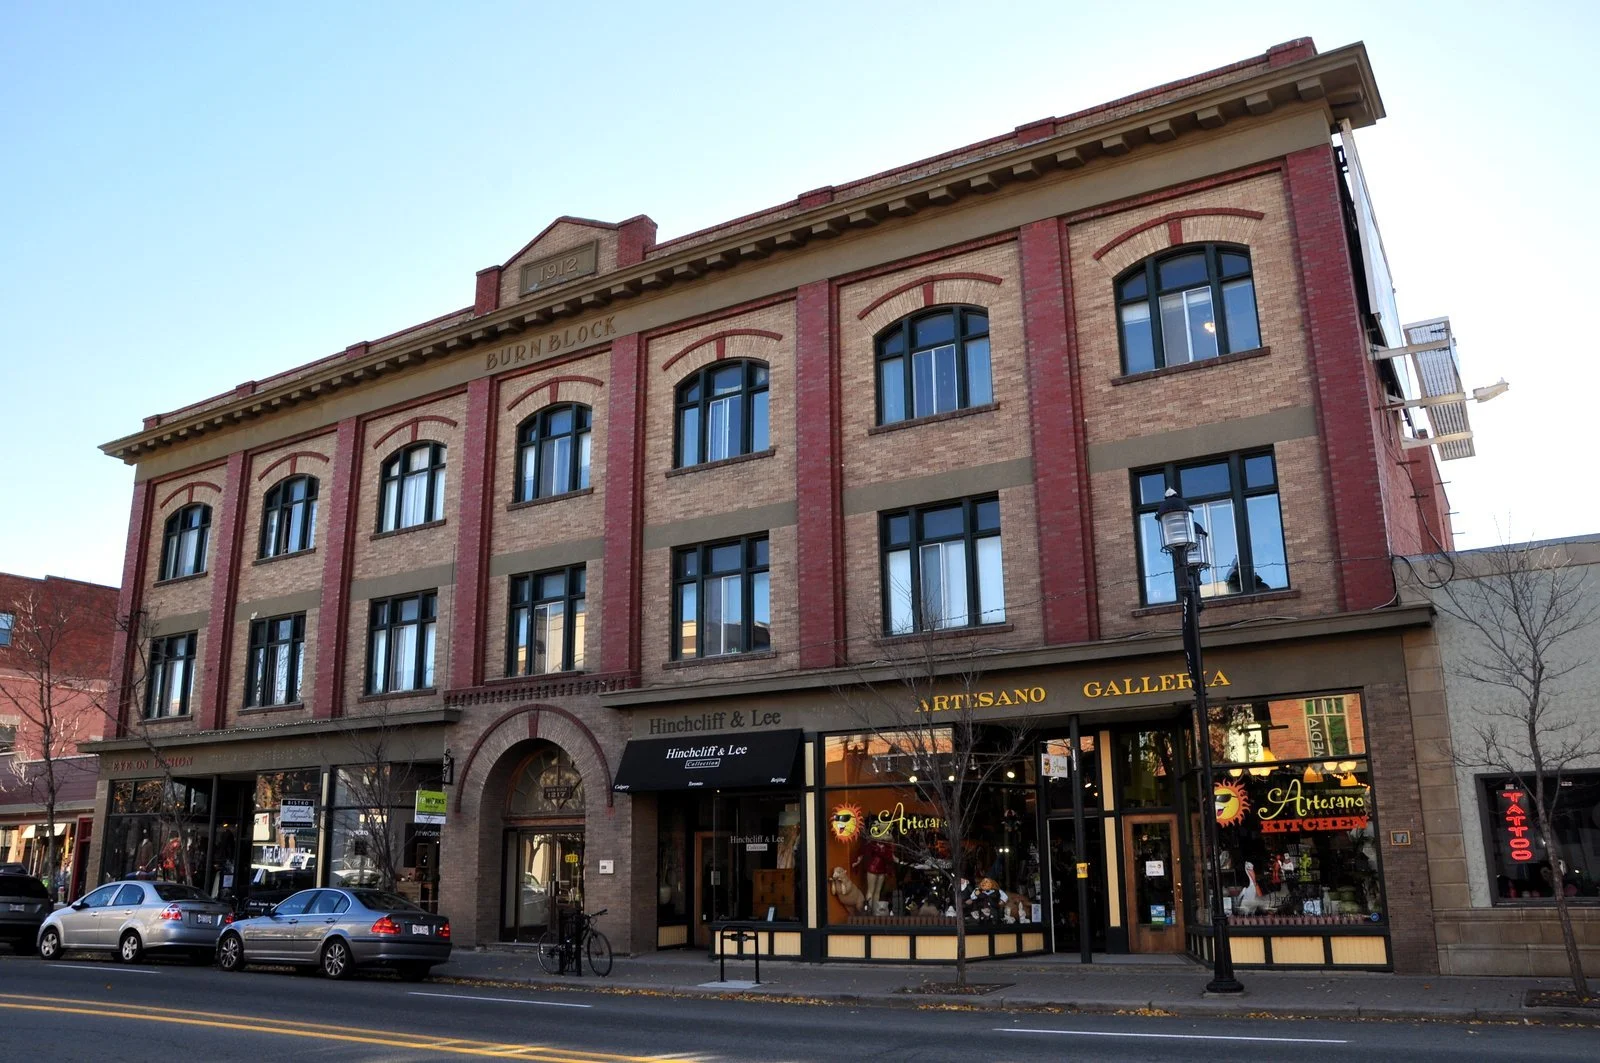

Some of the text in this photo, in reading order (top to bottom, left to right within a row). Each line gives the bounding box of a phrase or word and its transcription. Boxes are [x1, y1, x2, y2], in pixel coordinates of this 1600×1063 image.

[538, 256, 579, 283] 1912
[485, 315, 617, 371] BURN BLOCK
[914, 670, 1232, 713] ARTESANO GALLERA
[649, 709, 782, 735] Hinchcliff & Lee
[111, 759, 132, 772] EYE
[136, 759, 149, 770] ON
[665, 745, 748, 760] Hinchcliff & Lee
[686, 760, 719, 768] Collection
[1258, 778, 1365, 820] Artesano
[1260, 815, 1369, 834] KITCHEN
[1502, 792, 1533, 861] TATTOO
[730, 834, 764, 844] Hinchcliff
[771, 834, 785, 843] Lee
